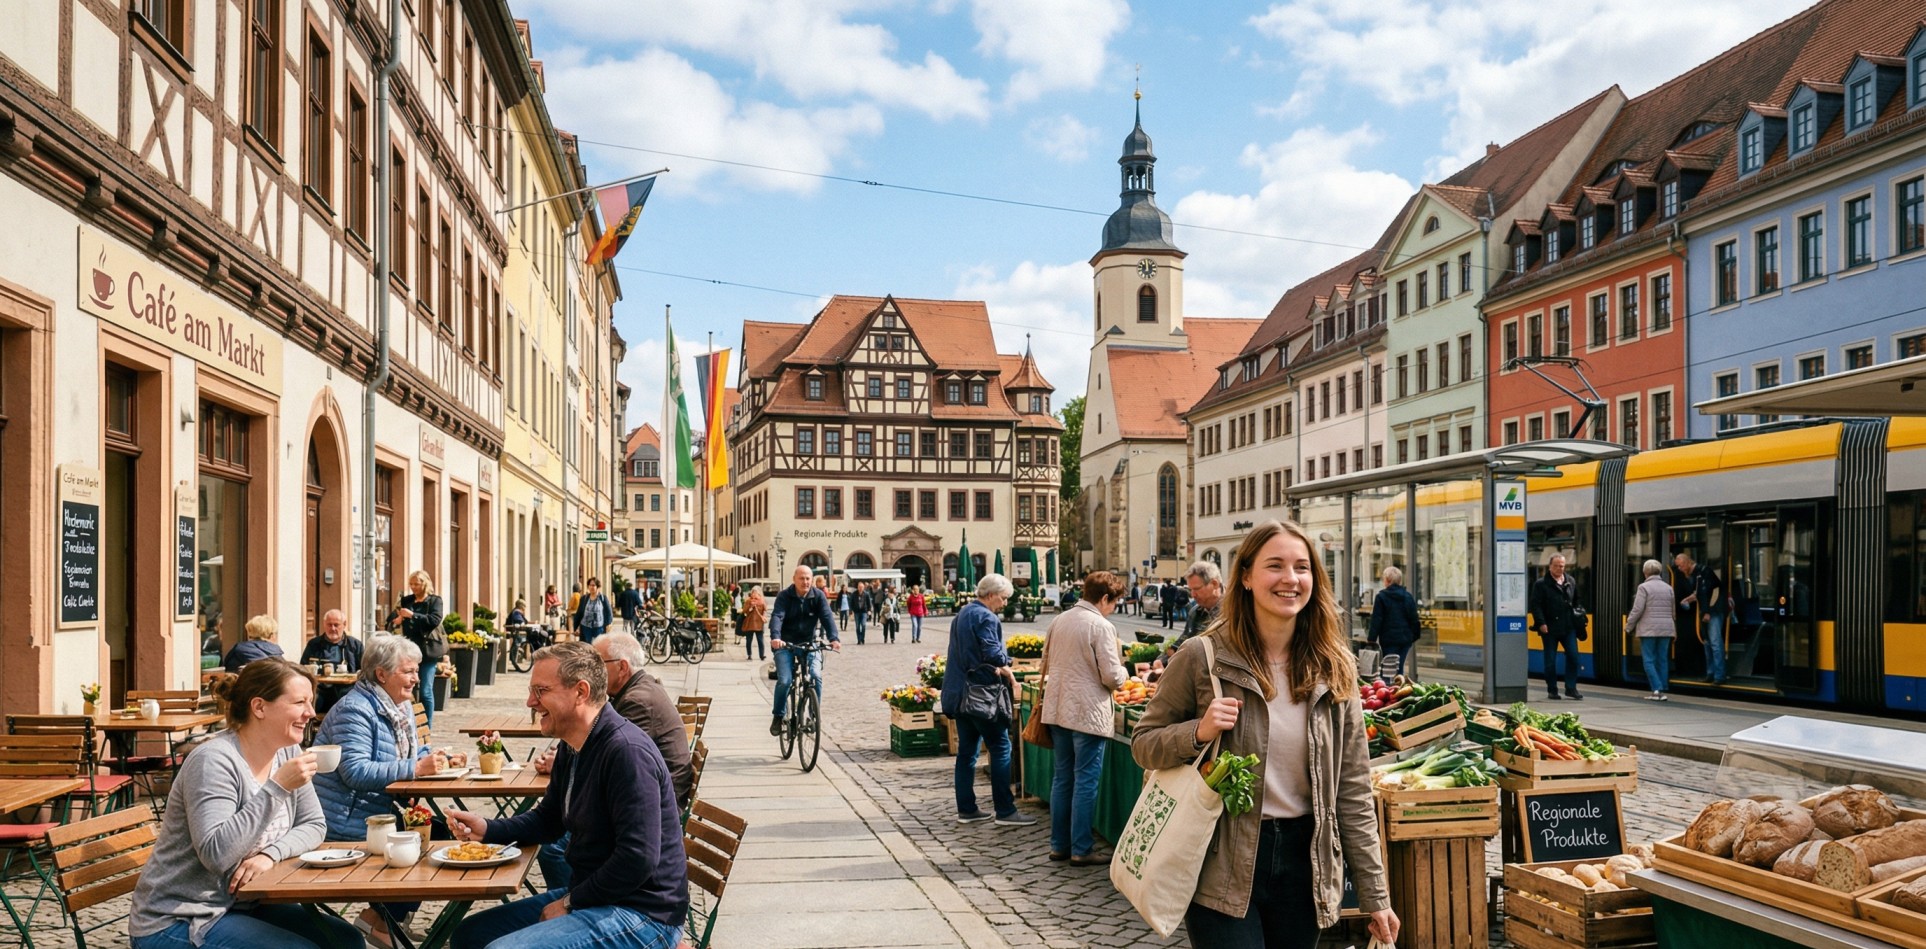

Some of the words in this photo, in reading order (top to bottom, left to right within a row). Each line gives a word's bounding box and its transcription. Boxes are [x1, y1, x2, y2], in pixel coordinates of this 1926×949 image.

[127, 271, 177, 335] Café
[184, 313, 212, 351] am
[217, 316, 265, 376] Markt
[1499, 501, 1522, 510] MVB
[794, 529, 832, 539] Regionale
[833, 529, 868, 538] Produkte
[1528, 799, 1603, 829] Regionale
[1540, 826, 1610, 849] Produkte
